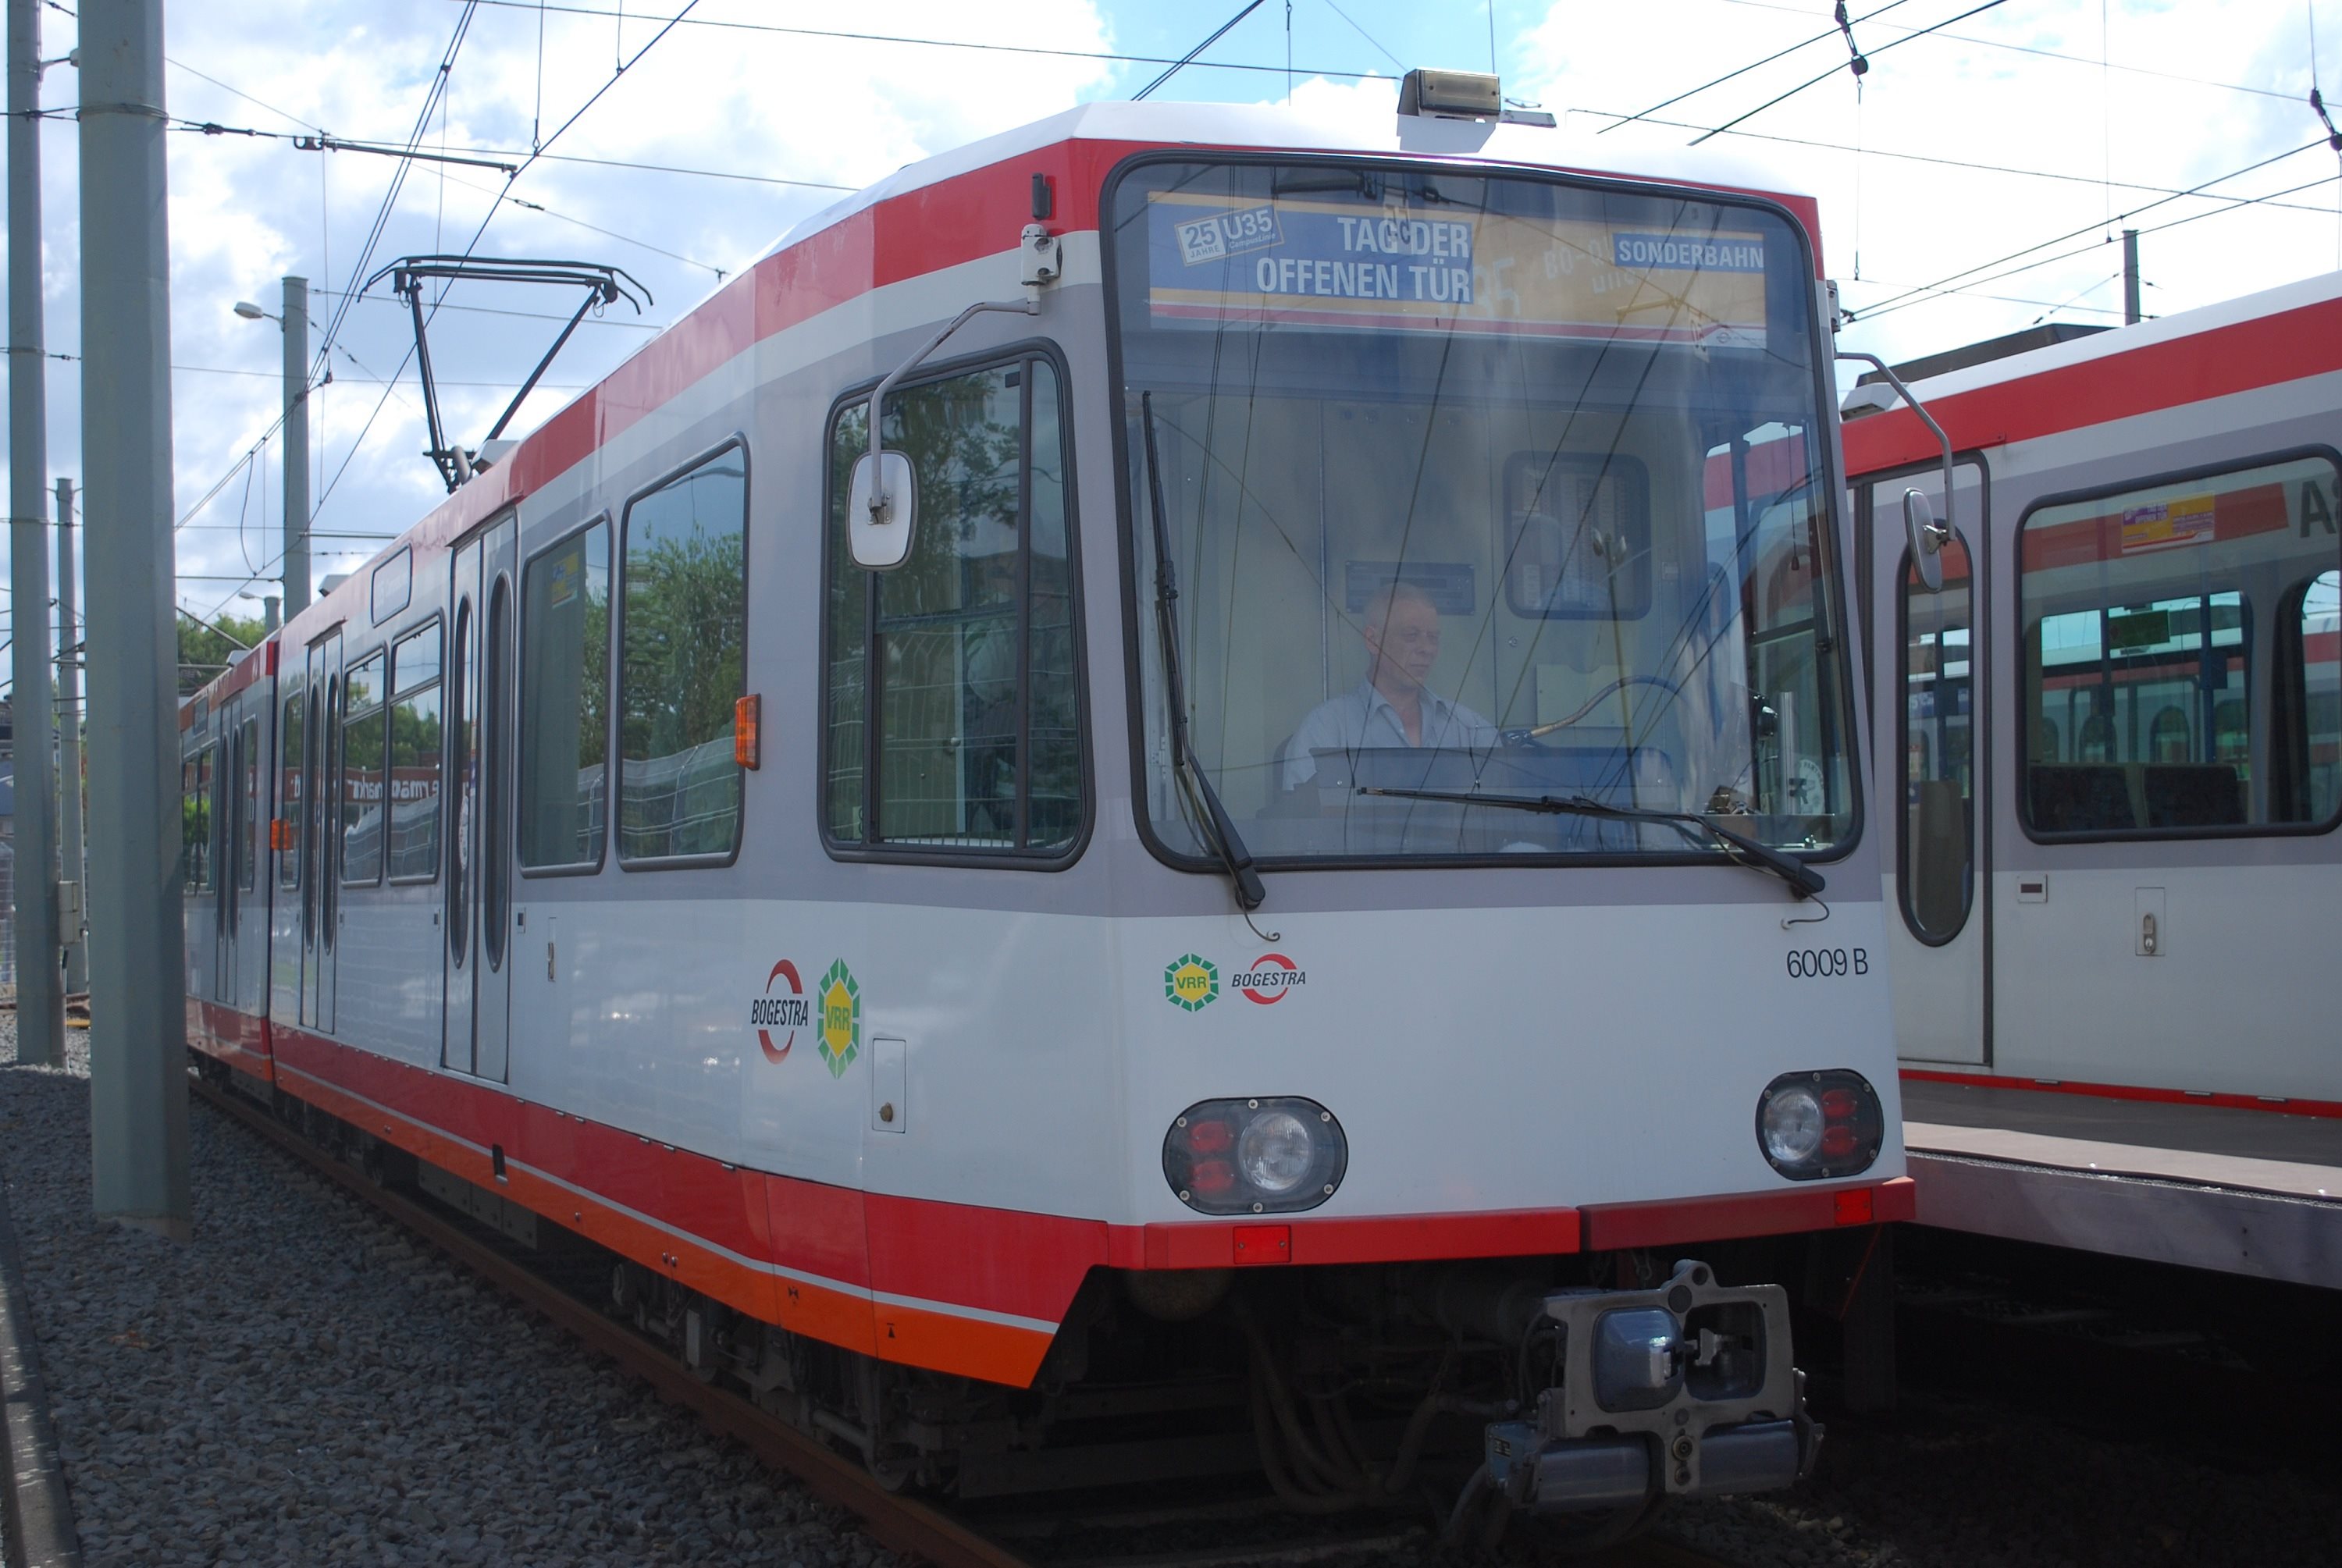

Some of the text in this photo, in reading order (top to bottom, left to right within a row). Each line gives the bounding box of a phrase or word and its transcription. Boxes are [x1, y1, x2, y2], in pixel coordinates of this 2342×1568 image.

[1185, 222, 1216, 250] 25
[1223, 209, 1272, 240] U35
[1337, 217, 1469, 258] TAG DER
[1190, 244, 1221, 258] JAHRE
[1618, 240, 1764, 268] SONDERBAHN
[1256, 258, 1470, 303] OFFENEN TÜR
[1786, 948, 1868, 978] 6009 B
[1176, 976, 1207, 989] VRR
[1231, 972, 1306, 987] BOGESTRA
[751, 999, 809, 1026] BOGESTRA
[826, 1005, 850, 1031] VRR
